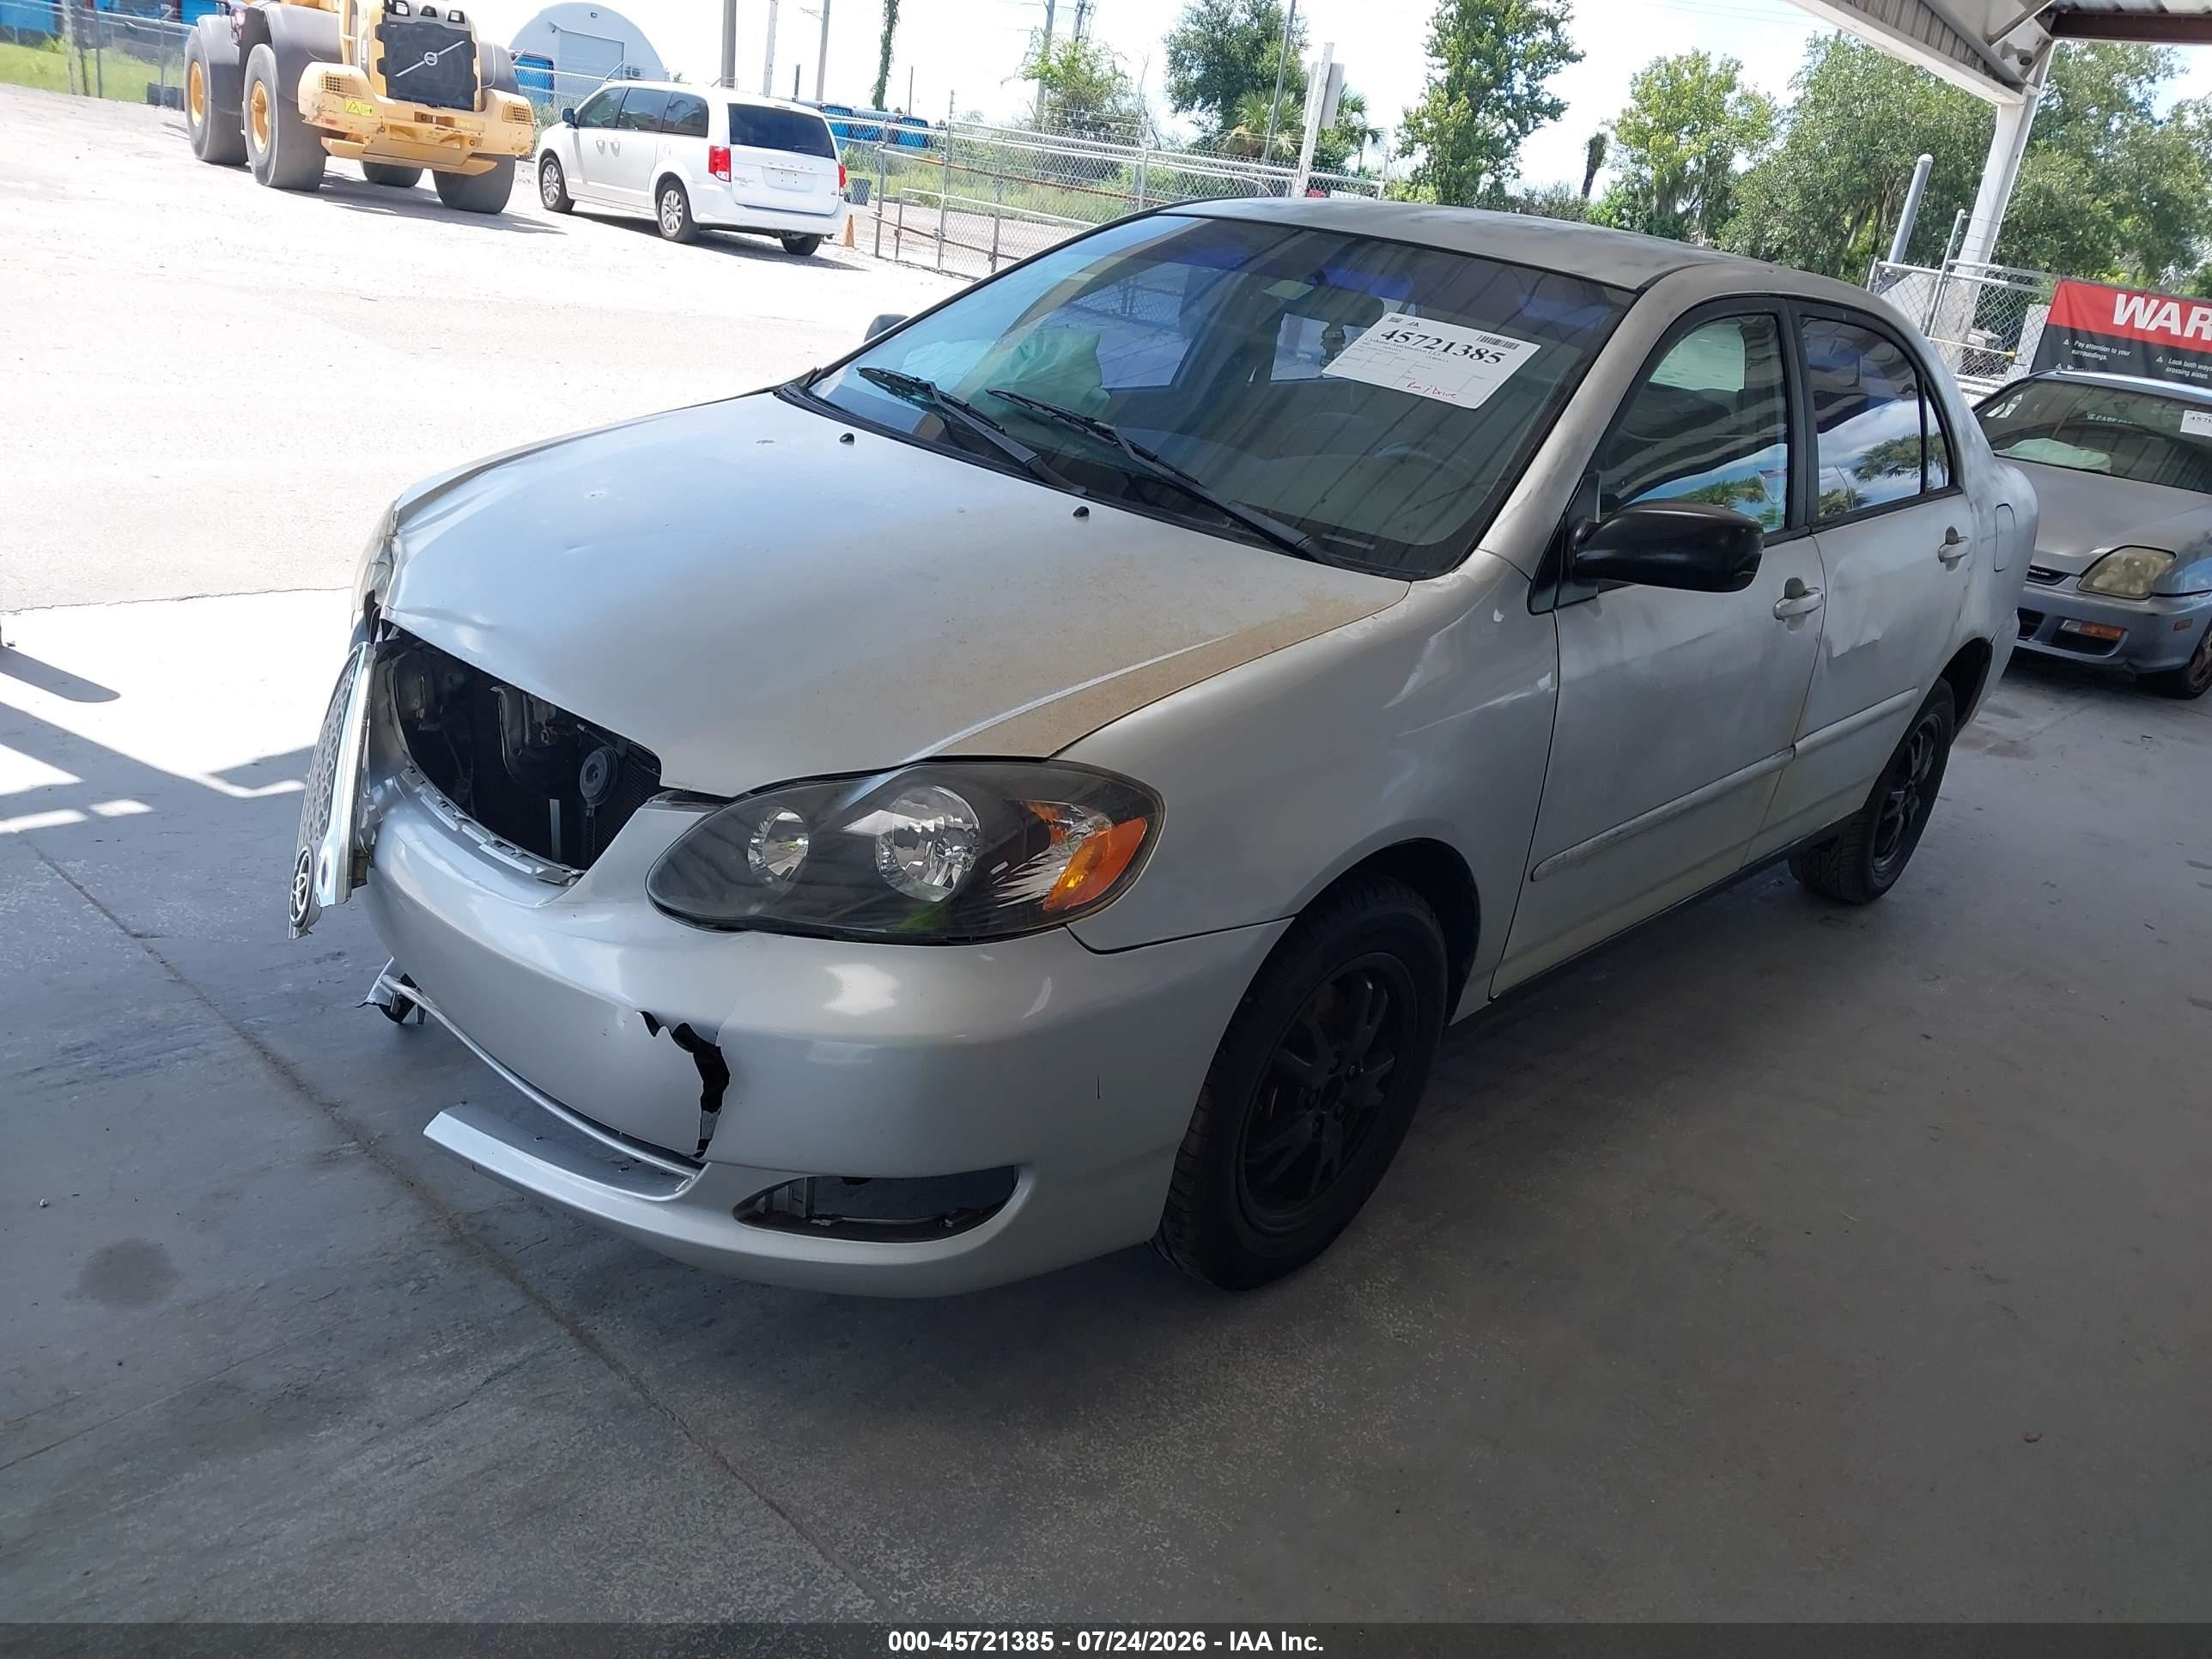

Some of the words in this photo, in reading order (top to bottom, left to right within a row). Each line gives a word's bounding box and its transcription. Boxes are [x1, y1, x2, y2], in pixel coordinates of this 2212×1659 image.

[2113, 294, 2212, 341] WAR
[1380, 329, 1507, 364] 45721385
[1390, 343, 1429, 353] Automotive
[2074, 340, 2086, 349] Pay
[2086, 343, 2110, 353] attention
[2168, 357, 2182, 366] Look
[2166, 367, 2190, 377] crossing
